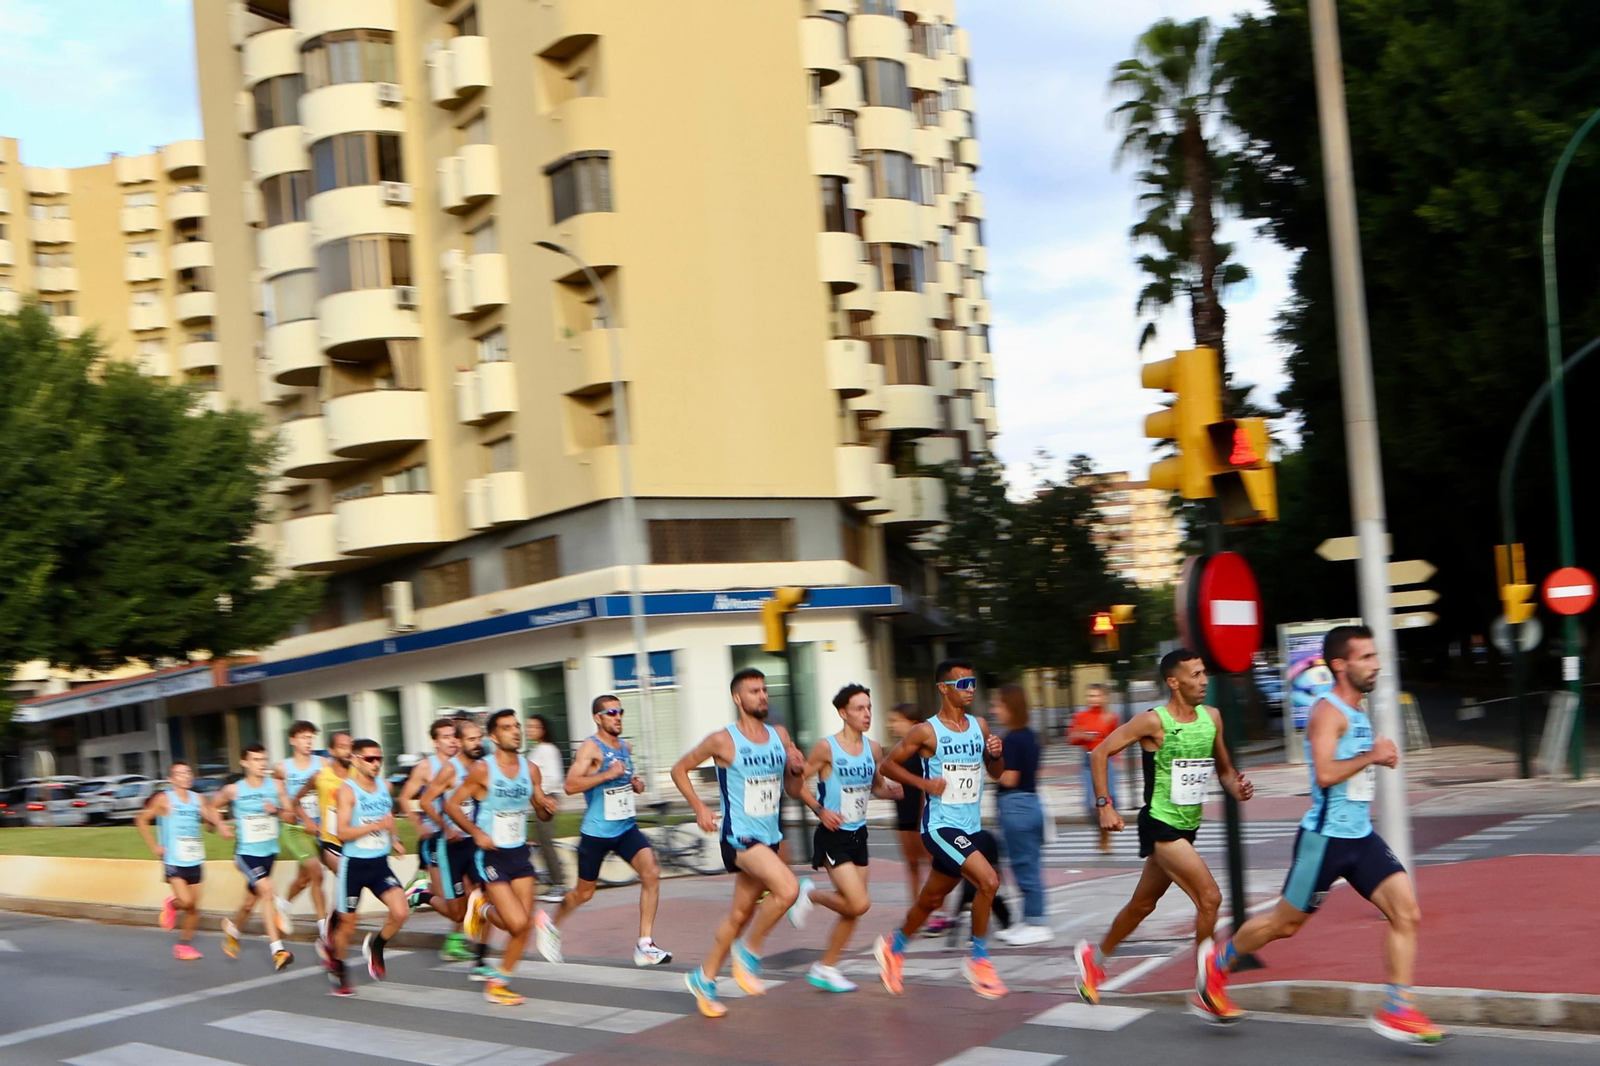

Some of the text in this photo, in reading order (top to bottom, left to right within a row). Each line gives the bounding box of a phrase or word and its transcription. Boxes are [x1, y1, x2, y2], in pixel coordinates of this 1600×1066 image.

[942, 739, 982, 756] nerja
[743, 750, 783, 769] nerja
[837, 763, 873, 779] nerja
[1181, 773, 1208, 785] 9845
[958, 778, 973, 789] 70
